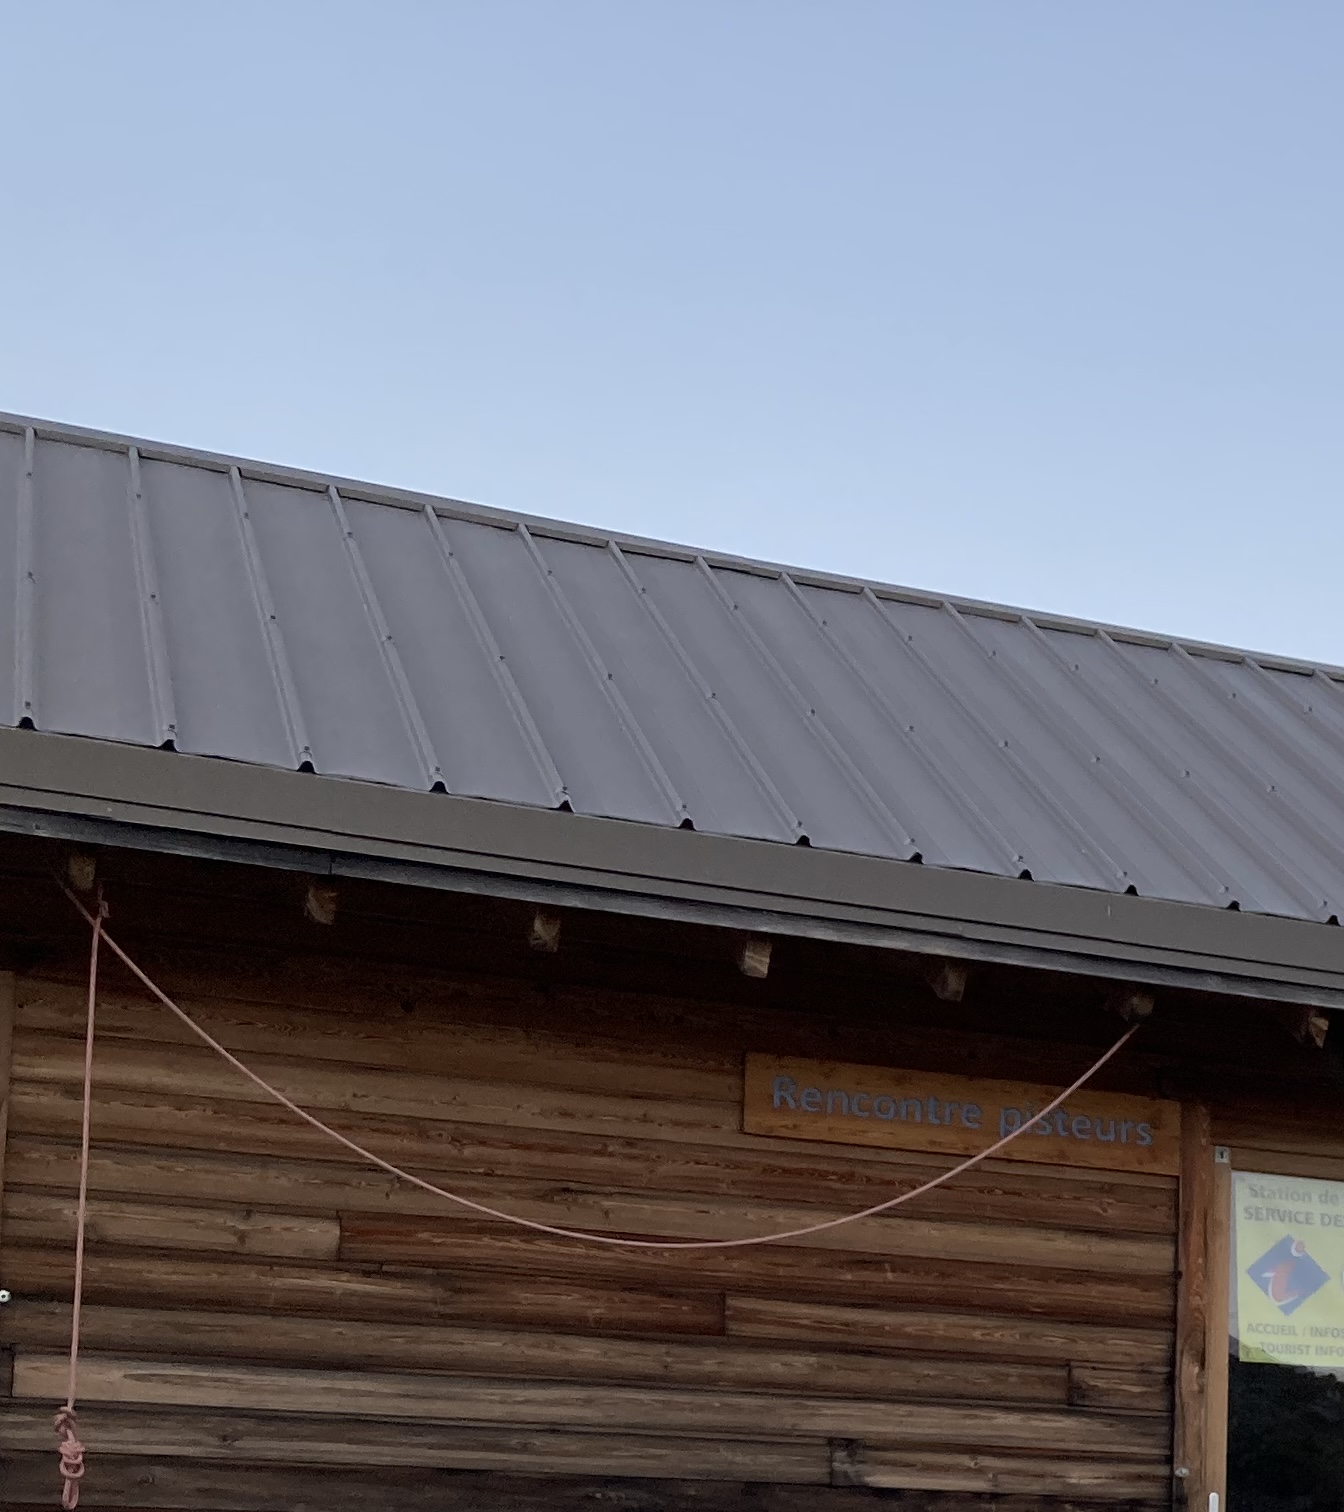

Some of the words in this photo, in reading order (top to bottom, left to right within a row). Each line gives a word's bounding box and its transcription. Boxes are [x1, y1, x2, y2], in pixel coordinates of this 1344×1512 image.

[772, 1075, 983, 1129] Rencontre
[999, 1102, 1154, 1147] pisteurs
[1249, 1183, 1312, 1205] Station
[1318, 1190, 1341, 1207] de
[1243, 1206, 1314, 1225] SERVICE
[1246, 1322, 1297, 1337] ACCUEIL
[1259, 1341, 1312, 1356] TOURIST
